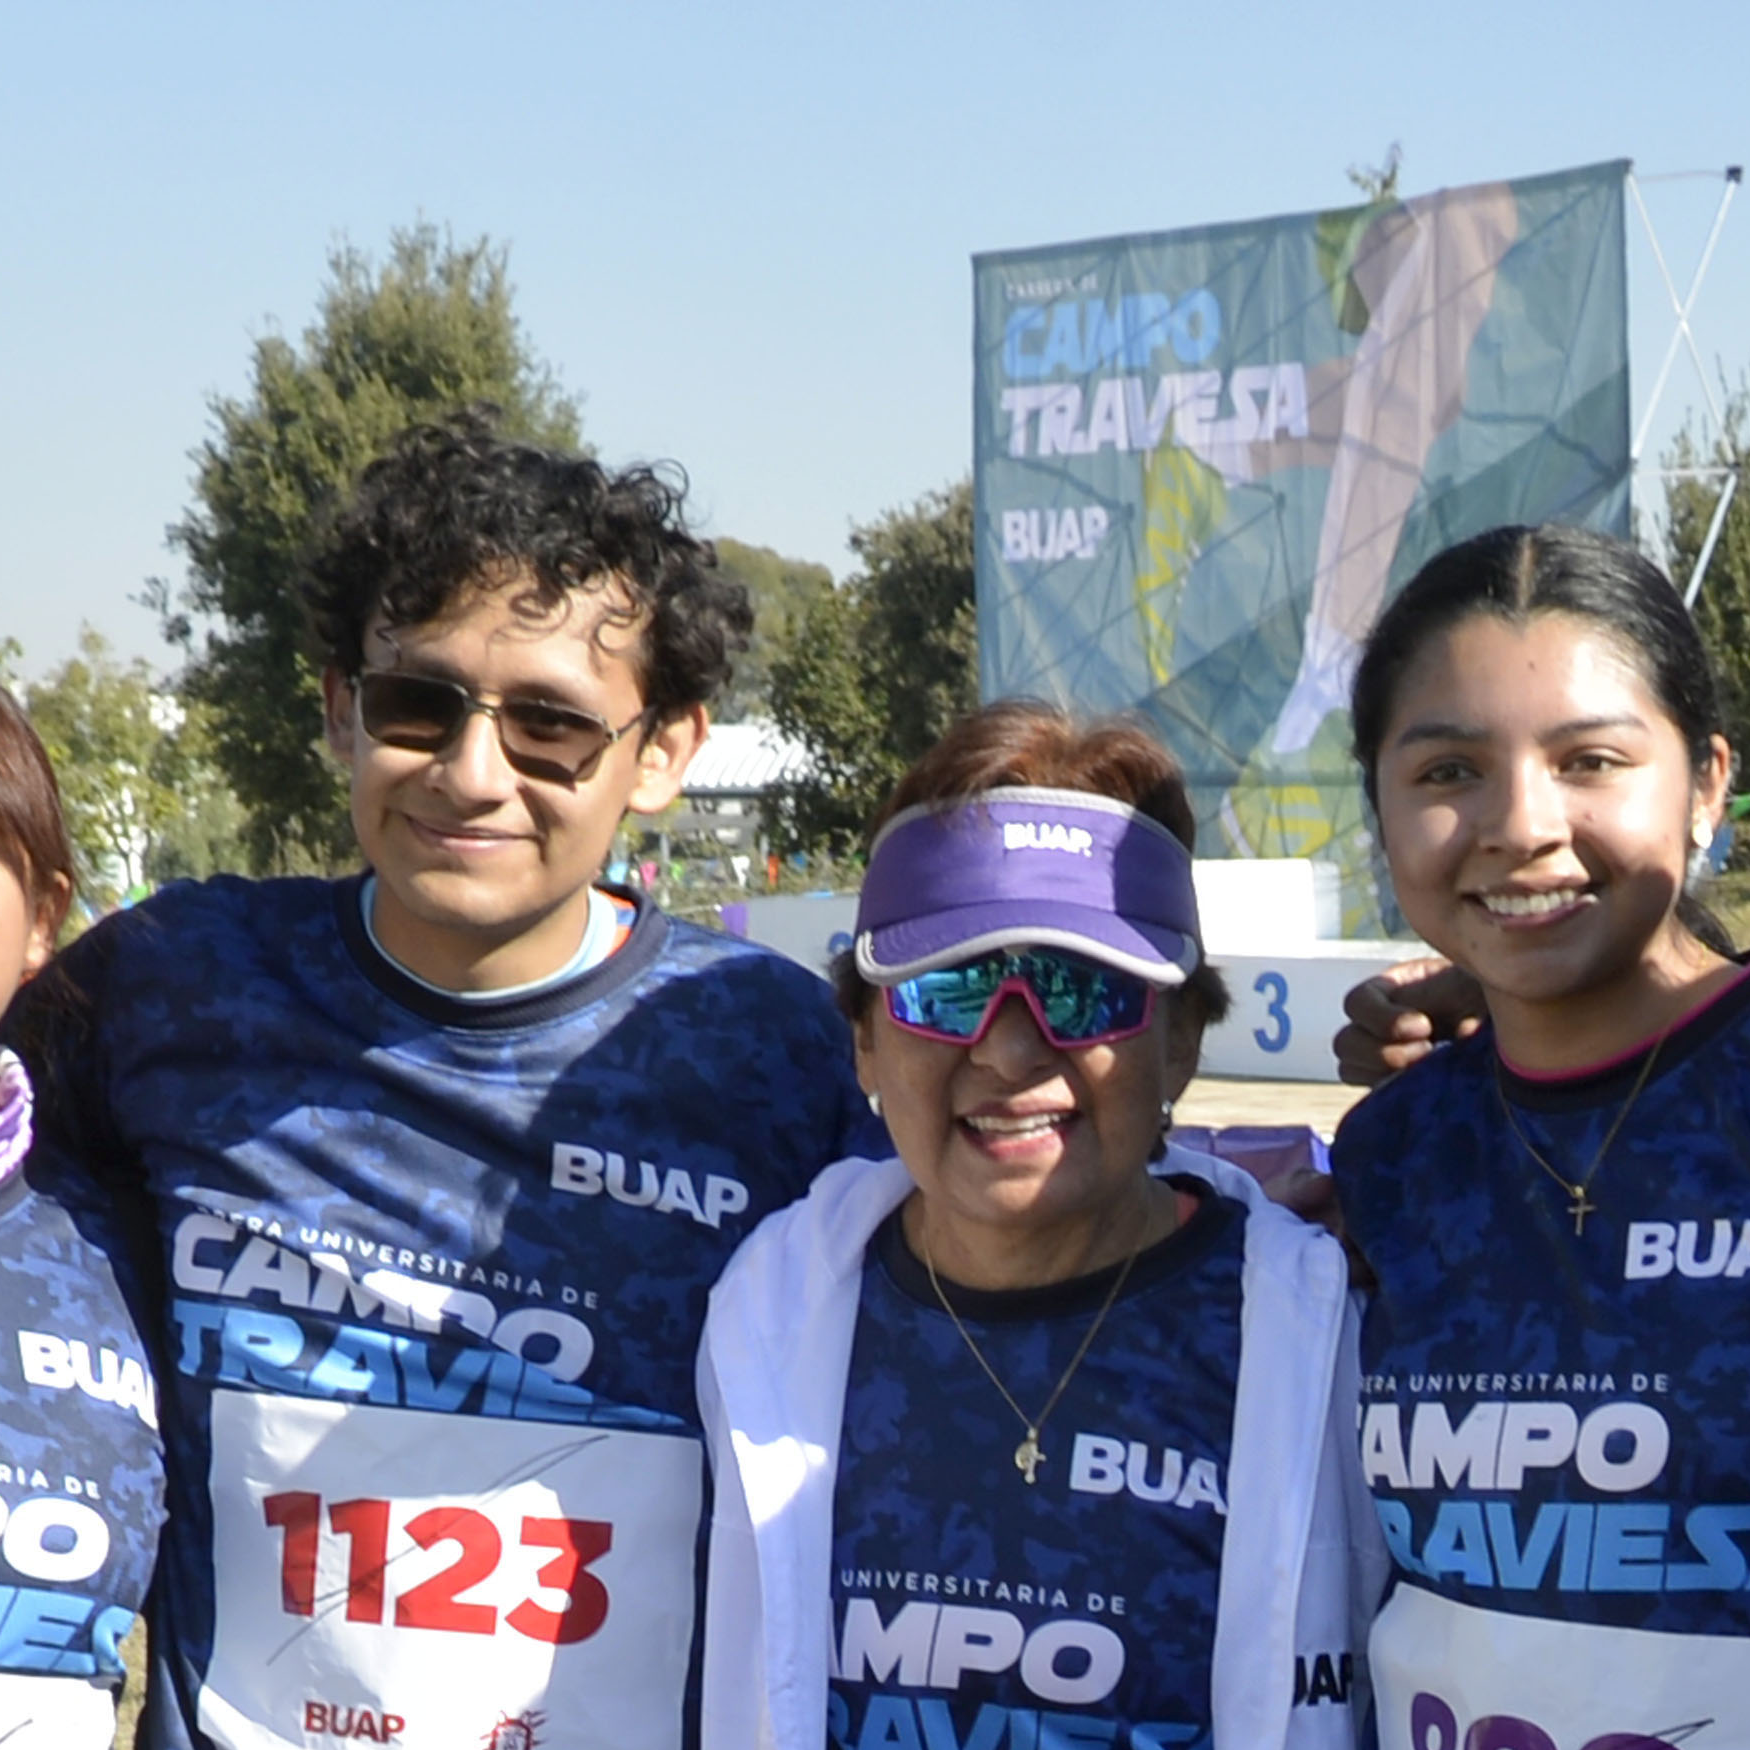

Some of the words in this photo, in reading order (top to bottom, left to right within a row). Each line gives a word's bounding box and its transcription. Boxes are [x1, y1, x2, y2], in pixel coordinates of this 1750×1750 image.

[1003, 287, 1221, 379] CAMPO
[1002, 505, 1108, 562] BUAP
[1002, 821, 1093, 858] BUAP
[1252, 970, 1293, 1054] 3
[550, 1141, 749, 1229] BUAP
[172, 1213, 596, 1383] CAMPO
[300, 1227, 544, 1299] UNIVERSITARIA
[561, 1285, 600, 1310] DE
[17, 1328, 158, 1428] BUA
[1409, 1373, 1617, 1394] UNIVERSITARIA
[1631, 1373, 1670, 1394] DE
[64, 1474, 101, 1500] DE
[1069, 1432, 1229, 1516] BUA
[1355, 1402, 1671, 1492] AMPO
[262, 1489, 614, 1646] 1123
[840, 1568, 1069, 1608] UNIVERSITARIA
[1087, 1592, 1127, 1617] DE
[304, 1699, 406, 1744] BUAP
